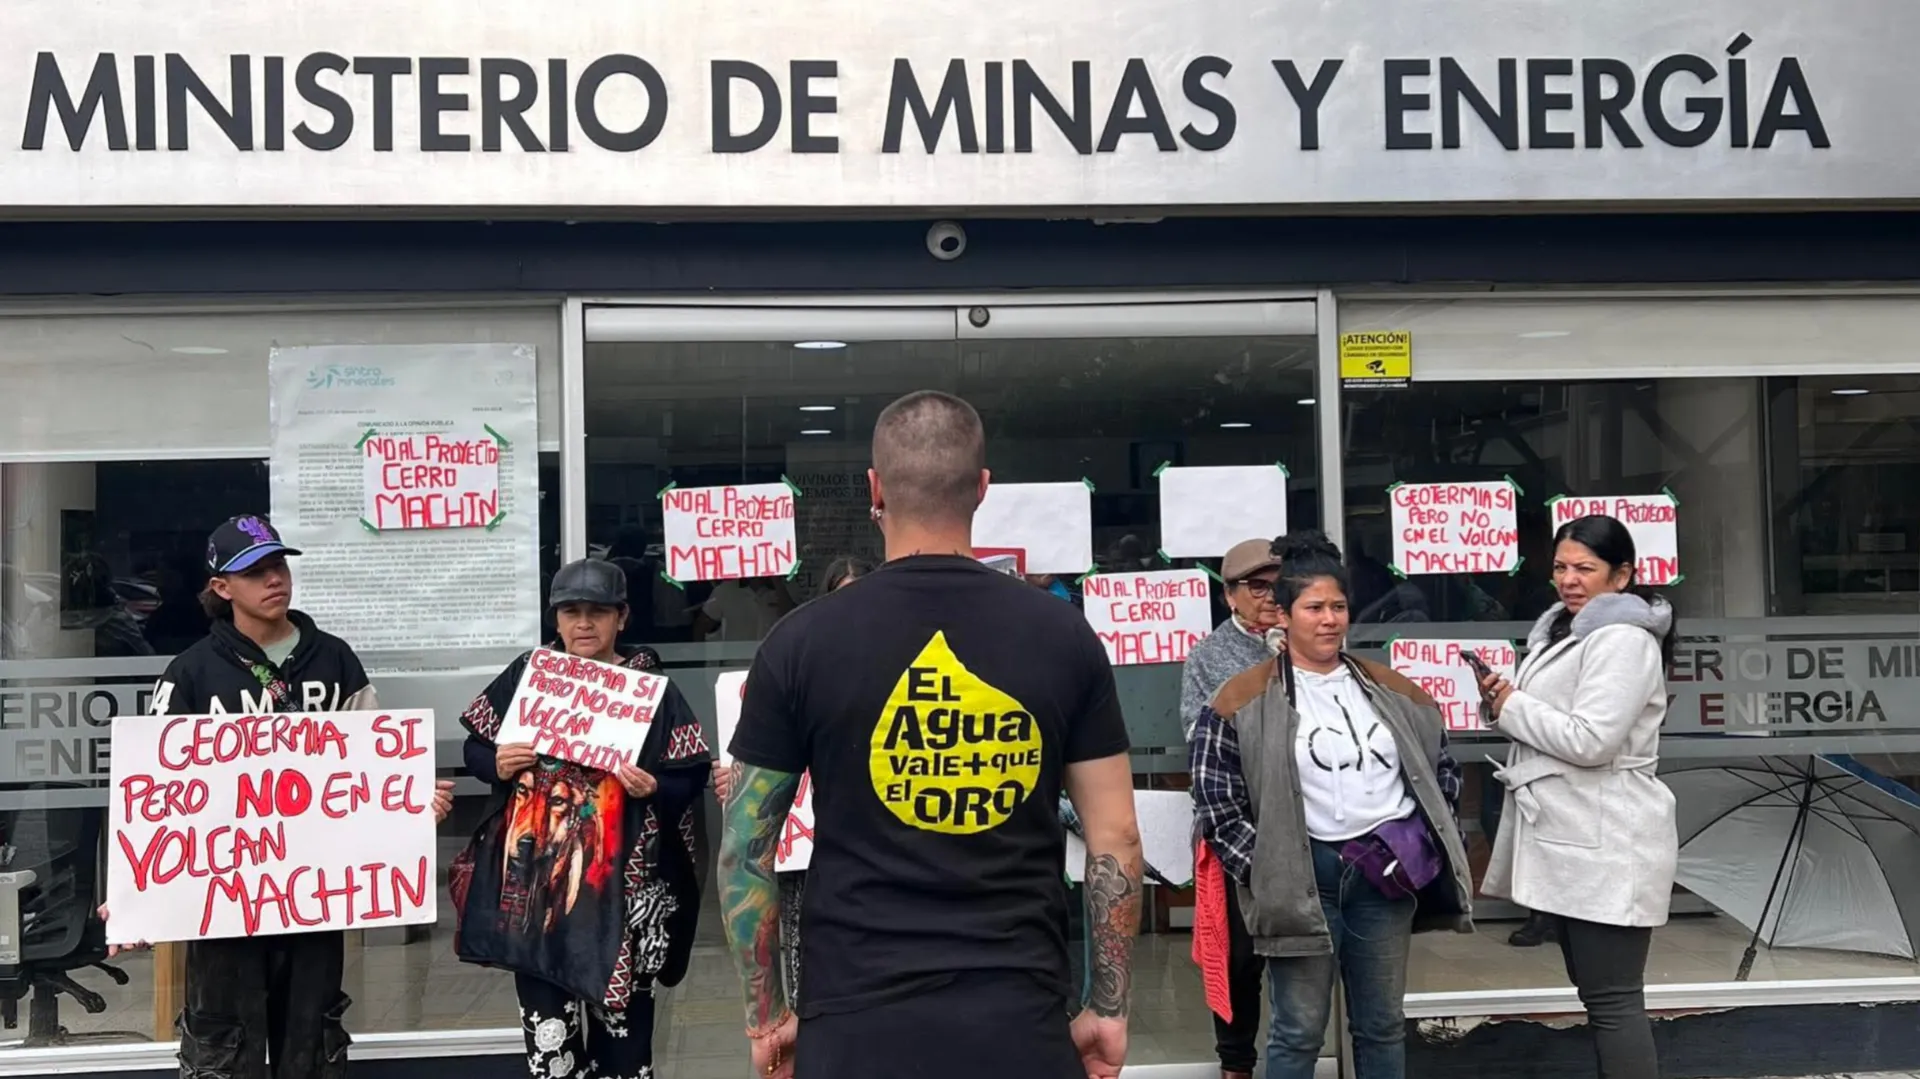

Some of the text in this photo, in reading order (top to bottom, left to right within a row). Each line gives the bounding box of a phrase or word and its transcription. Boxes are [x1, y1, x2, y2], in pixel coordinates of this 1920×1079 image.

[21, 32, 1831, 156] MINISTERIO DE MINAS Y ENERGÍA
[1343, 332, 1408, 347] ¡ATENCIÓN!
[337, 374, 396, 387] minerales
[366, 435, 499, 465] NO AL PROYECTO
[383, 462, 457, 490] CERRO
[375, 489, 497, 528] MACHIN
[665, 487, 795, 521] NO AL PROYECTO
[1394, 485, 1492, 509] GEOTERMIA
[1557, 499, 1585, 521] NO
[696, 517, 764, 538] CERRO
[1403, 528, 1425, 543] EN
[1428, 527, 1449, 544] EL
[1408, 507, 1490, 529] PERO NO
[670, 540, 792, 580] MACHIN
[1085, 577, 1207, 600] NO AL PROYECTO
[1110, 602, 1176, 622] CERRO
[530, 649, 627, 692] GEOTERMIA
[1393, 641, 1515, 667] NO AL PYECTO
[1786, 647, 1845, 680] DE
[1868, 645, 1920, 679] MI
[528, 670, 654, 724] PERO NO EN EL
[908, 667, 961, 702] EL
[1700, 690, 1888, 726] ENERGIA
[158, 714, 428, 771] GEOTERMIA SI
[883, 705, 1032, 751] Agua
[119, 768, 426, 823] PERO NO EN EL
[914, 780, 1025, 826] ORO
[117, 821, 287, 891] VOLCAN
[199, 855, 428, 937] MACHIN
